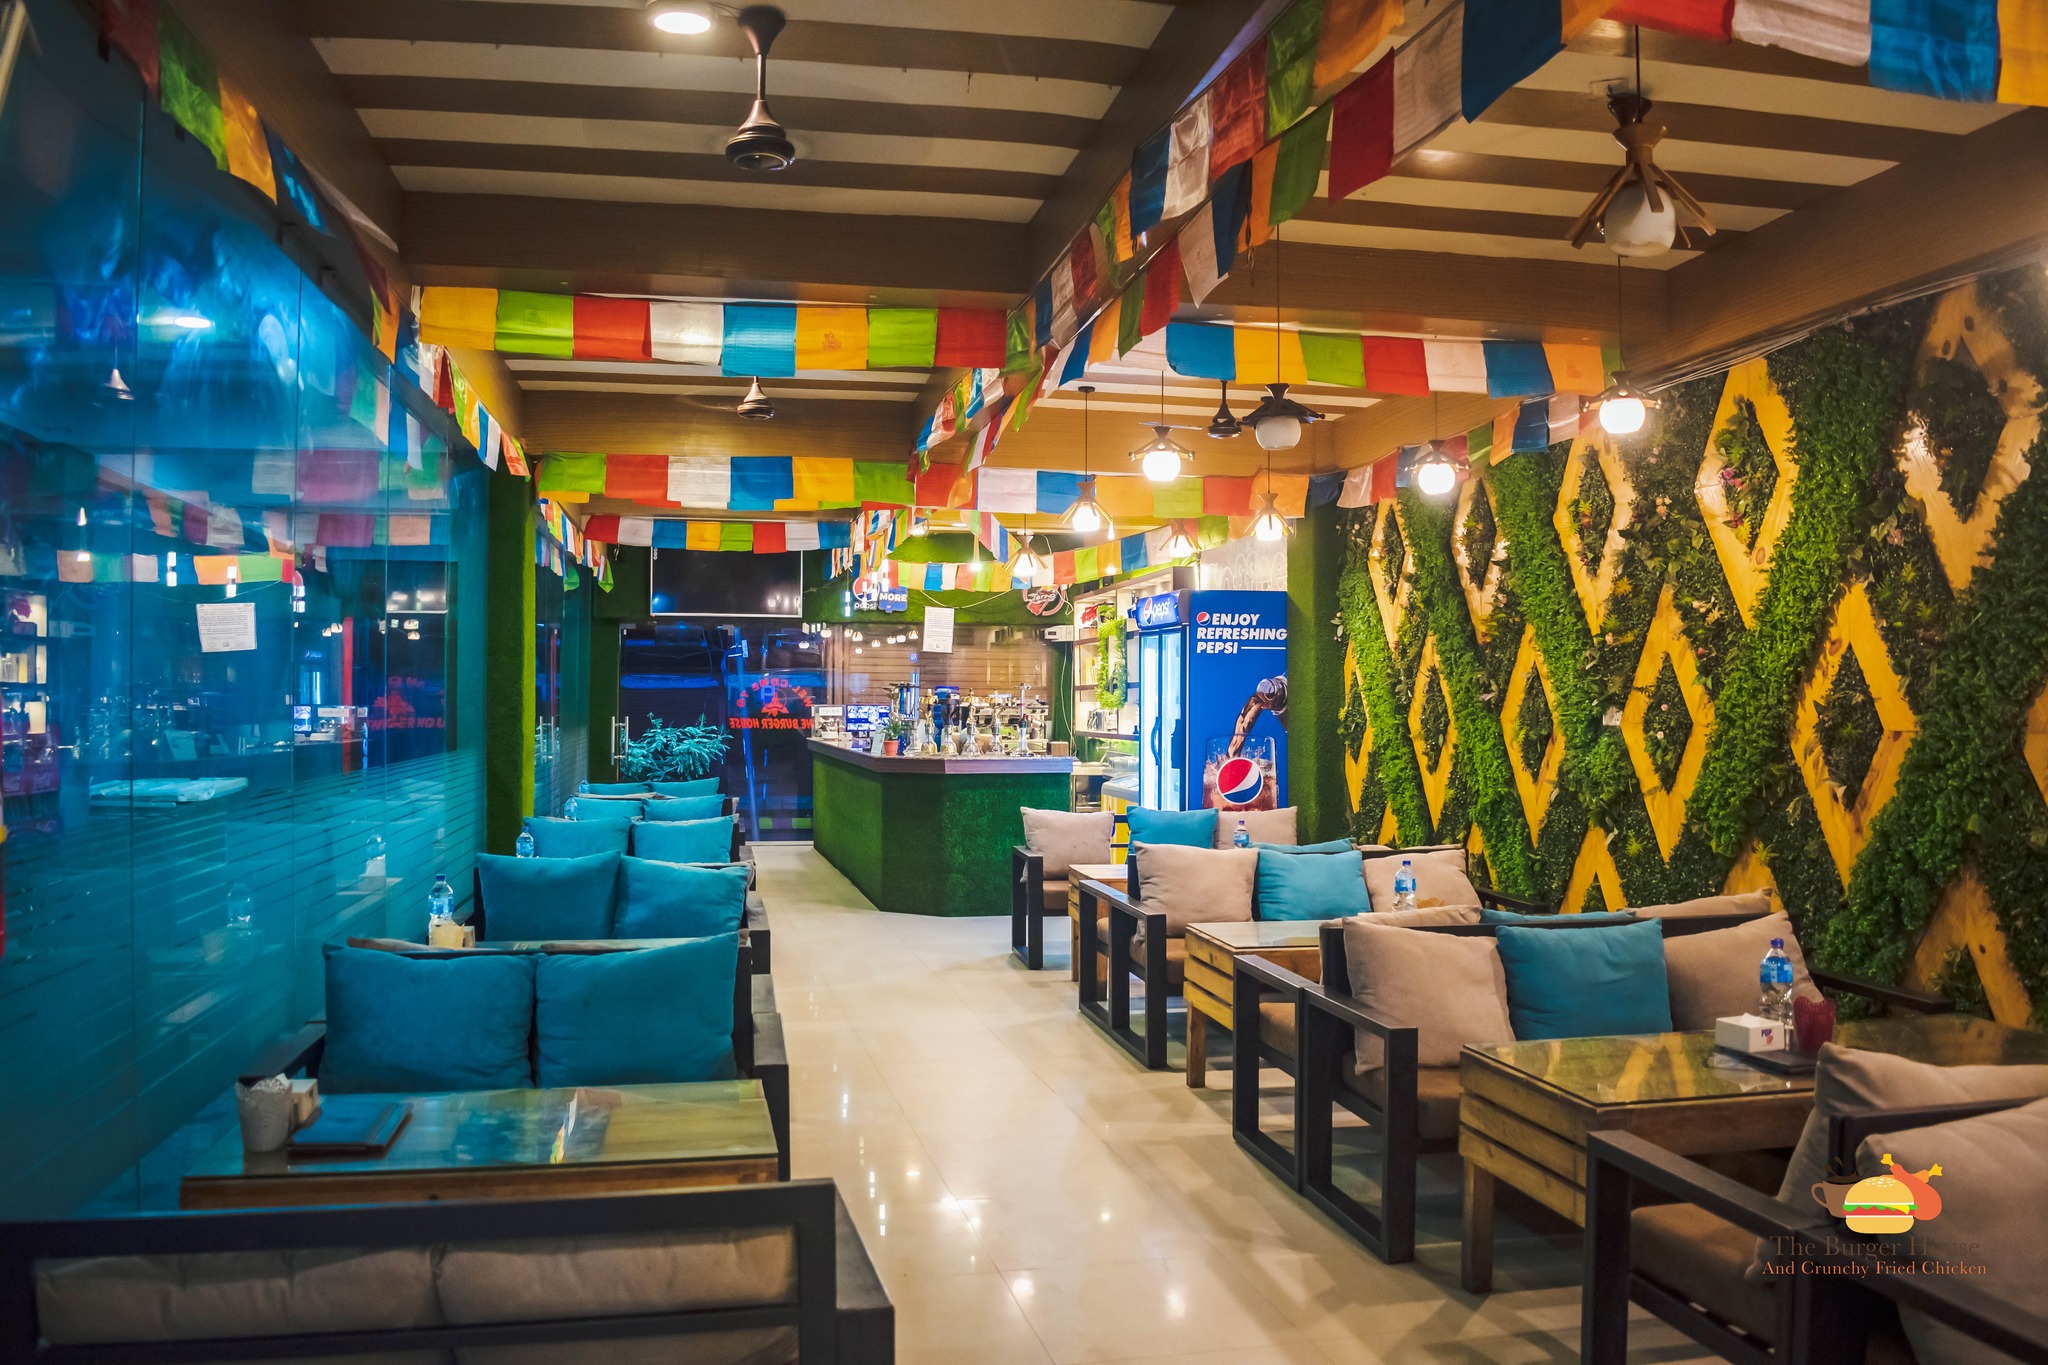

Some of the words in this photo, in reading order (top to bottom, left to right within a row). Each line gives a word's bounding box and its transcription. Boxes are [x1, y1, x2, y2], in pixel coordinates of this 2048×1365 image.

[880, 593, 907, 602] MORE
[1153, 598, 1171, 621] pepsi
[1212, 613, 1260, 626] ENJOY
[1196, 627, 1288, 640] REFRESHING
[1196, 641, 1238, 654] PEPSI
[1761, 1028, 1773, 1037] POP
